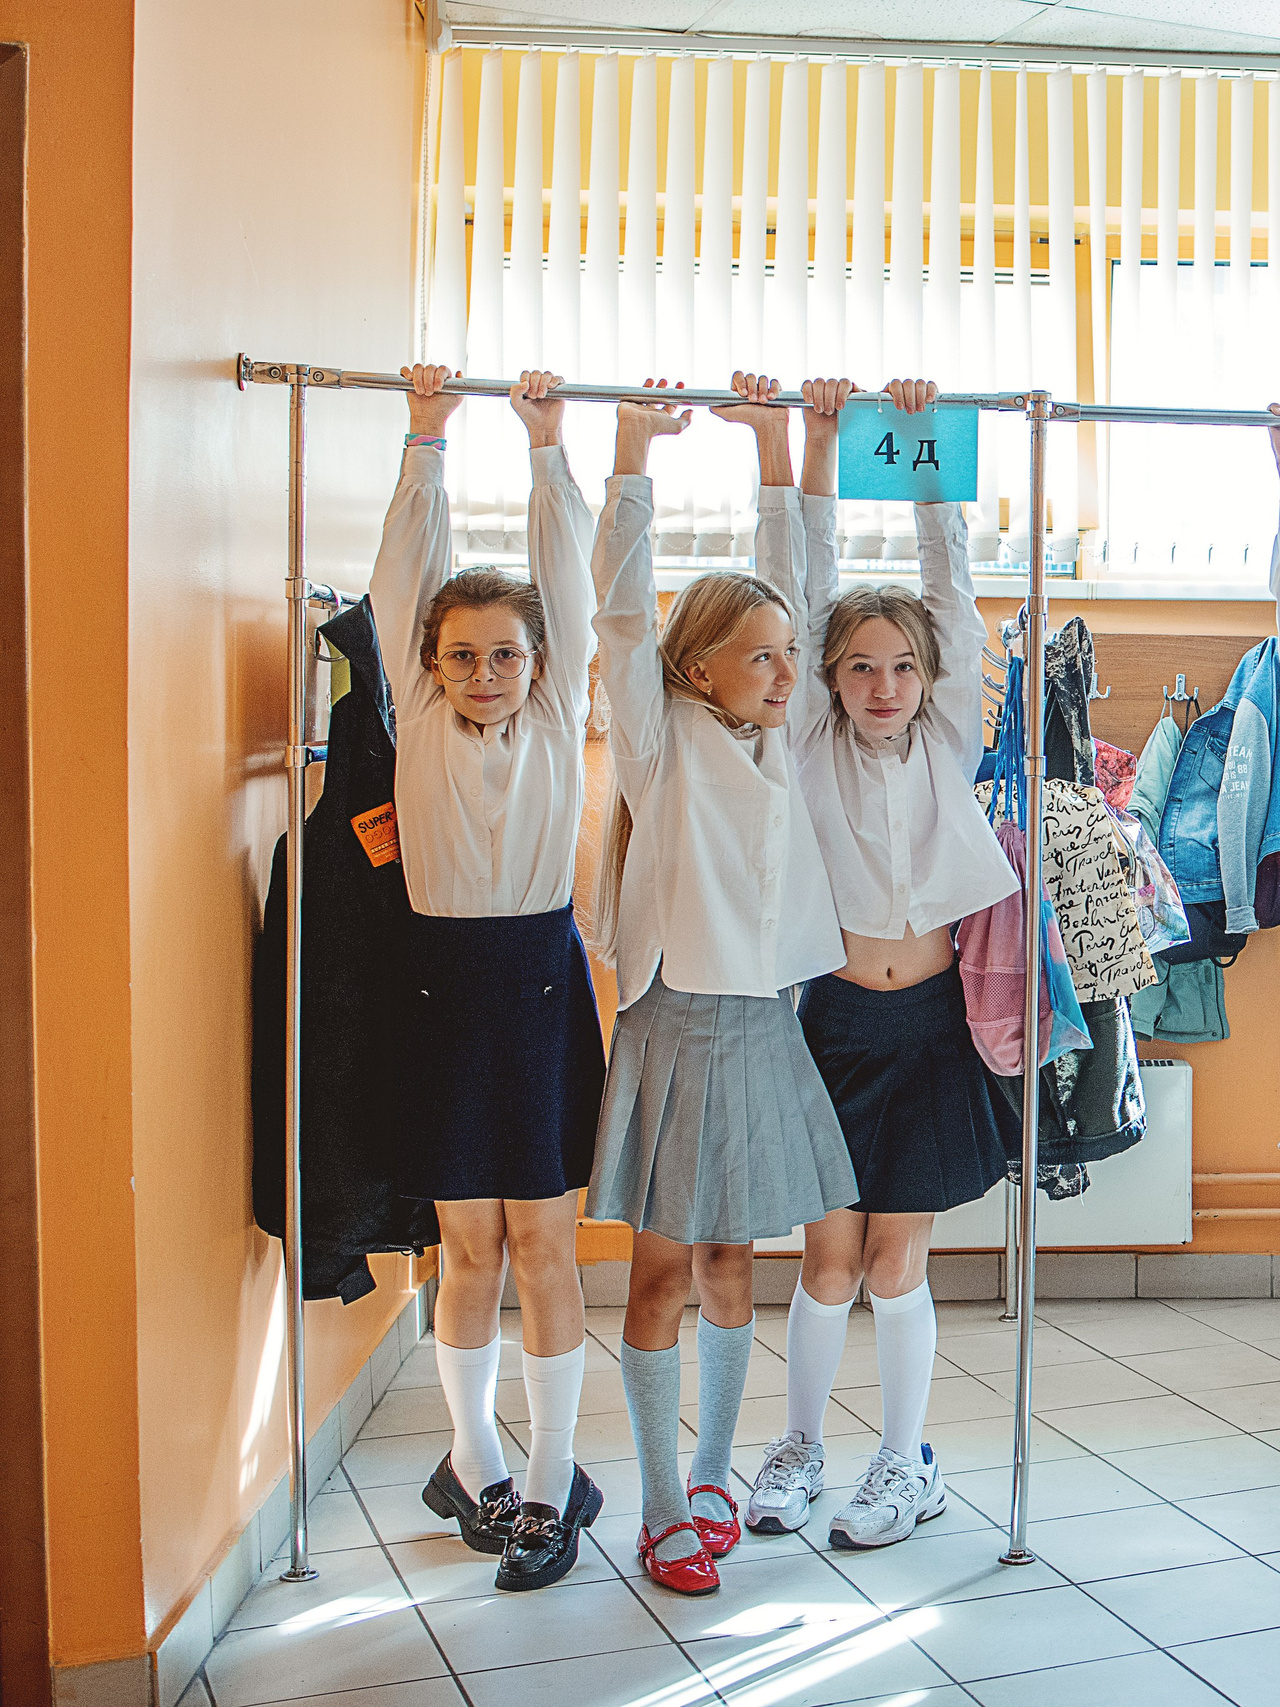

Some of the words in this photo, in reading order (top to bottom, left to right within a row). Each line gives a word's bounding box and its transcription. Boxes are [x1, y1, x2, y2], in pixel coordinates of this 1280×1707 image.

[874, 432, 900, 464] 4
[912, 440, 939, 471] д
[1237, 764, 1248, 774] 88
[358, 812, 393, 834] SUPER
[899, 1482, 919, 1504] N
